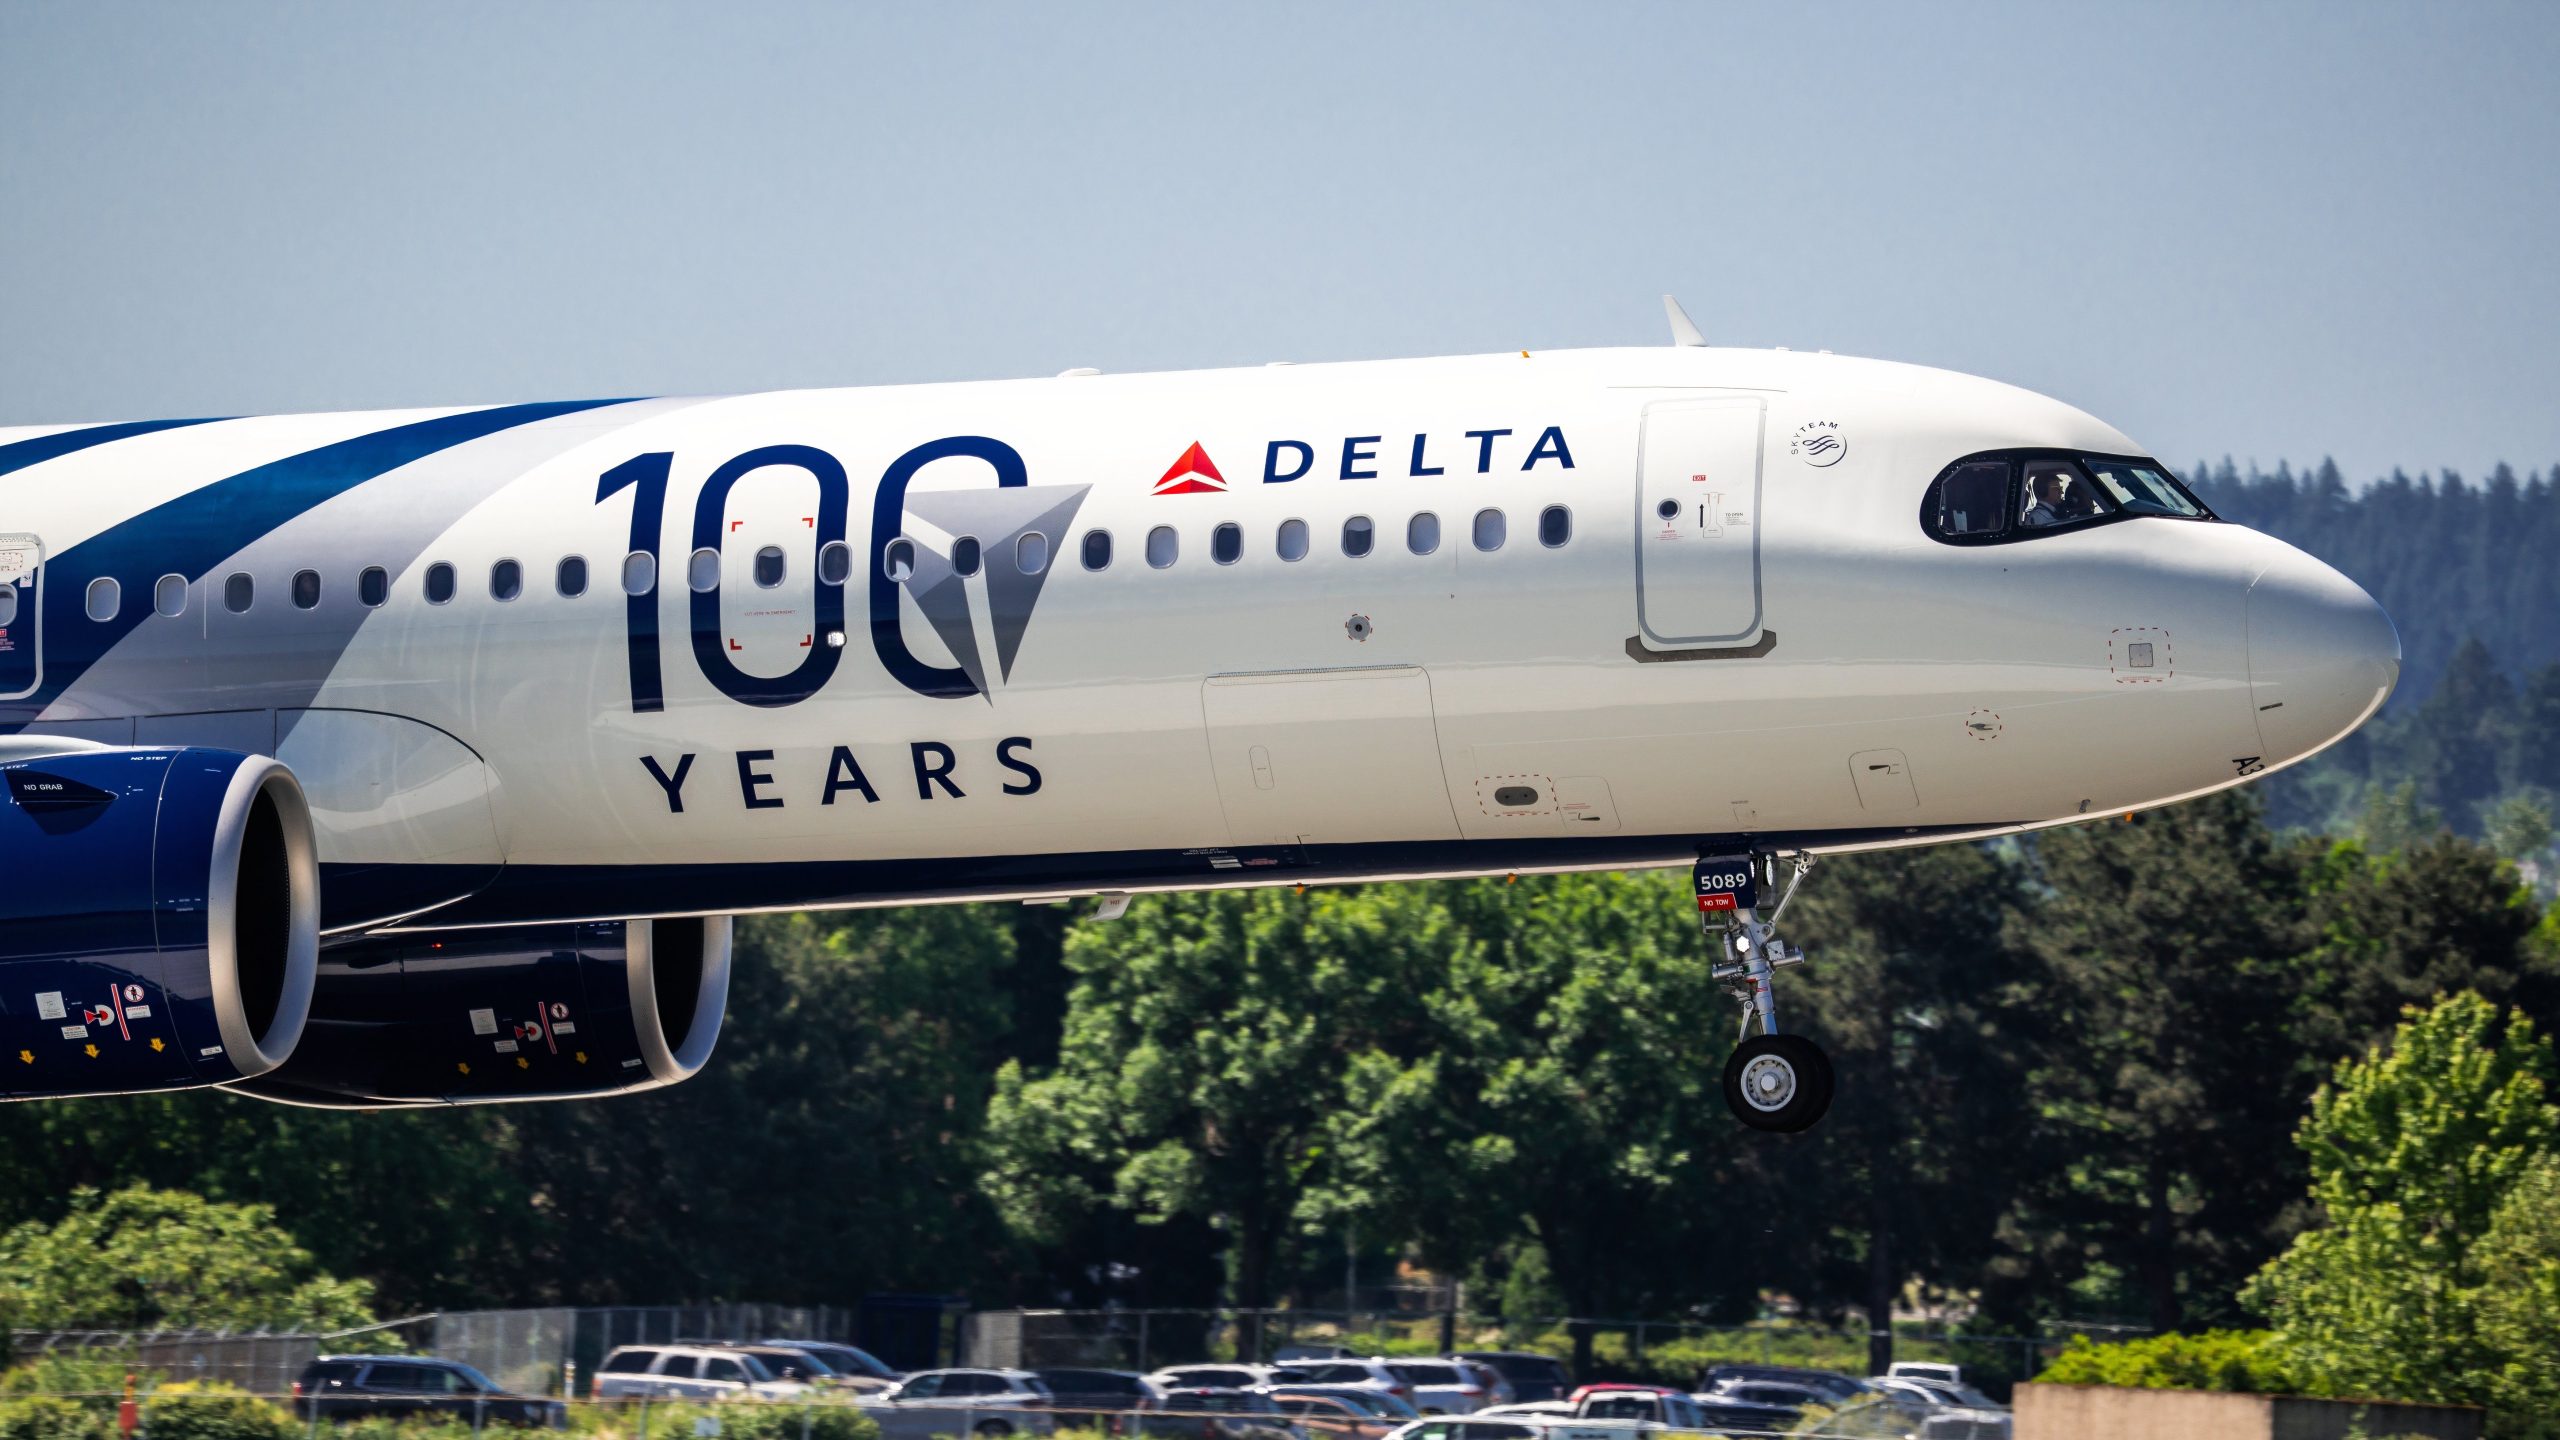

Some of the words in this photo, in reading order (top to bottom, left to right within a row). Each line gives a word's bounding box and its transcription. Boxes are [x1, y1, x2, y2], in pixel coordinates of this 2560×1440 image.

[1790, 421, 1838, 455] SKYTEAM
[1262, 426, 1575, 484] DELTA
[639, 736, 1042, 813] YEARS
[2232, 756, 2265, 776] A3
[39, 783, 63, 791] GRAB
[1701, 873, 1747, 890] 5089
